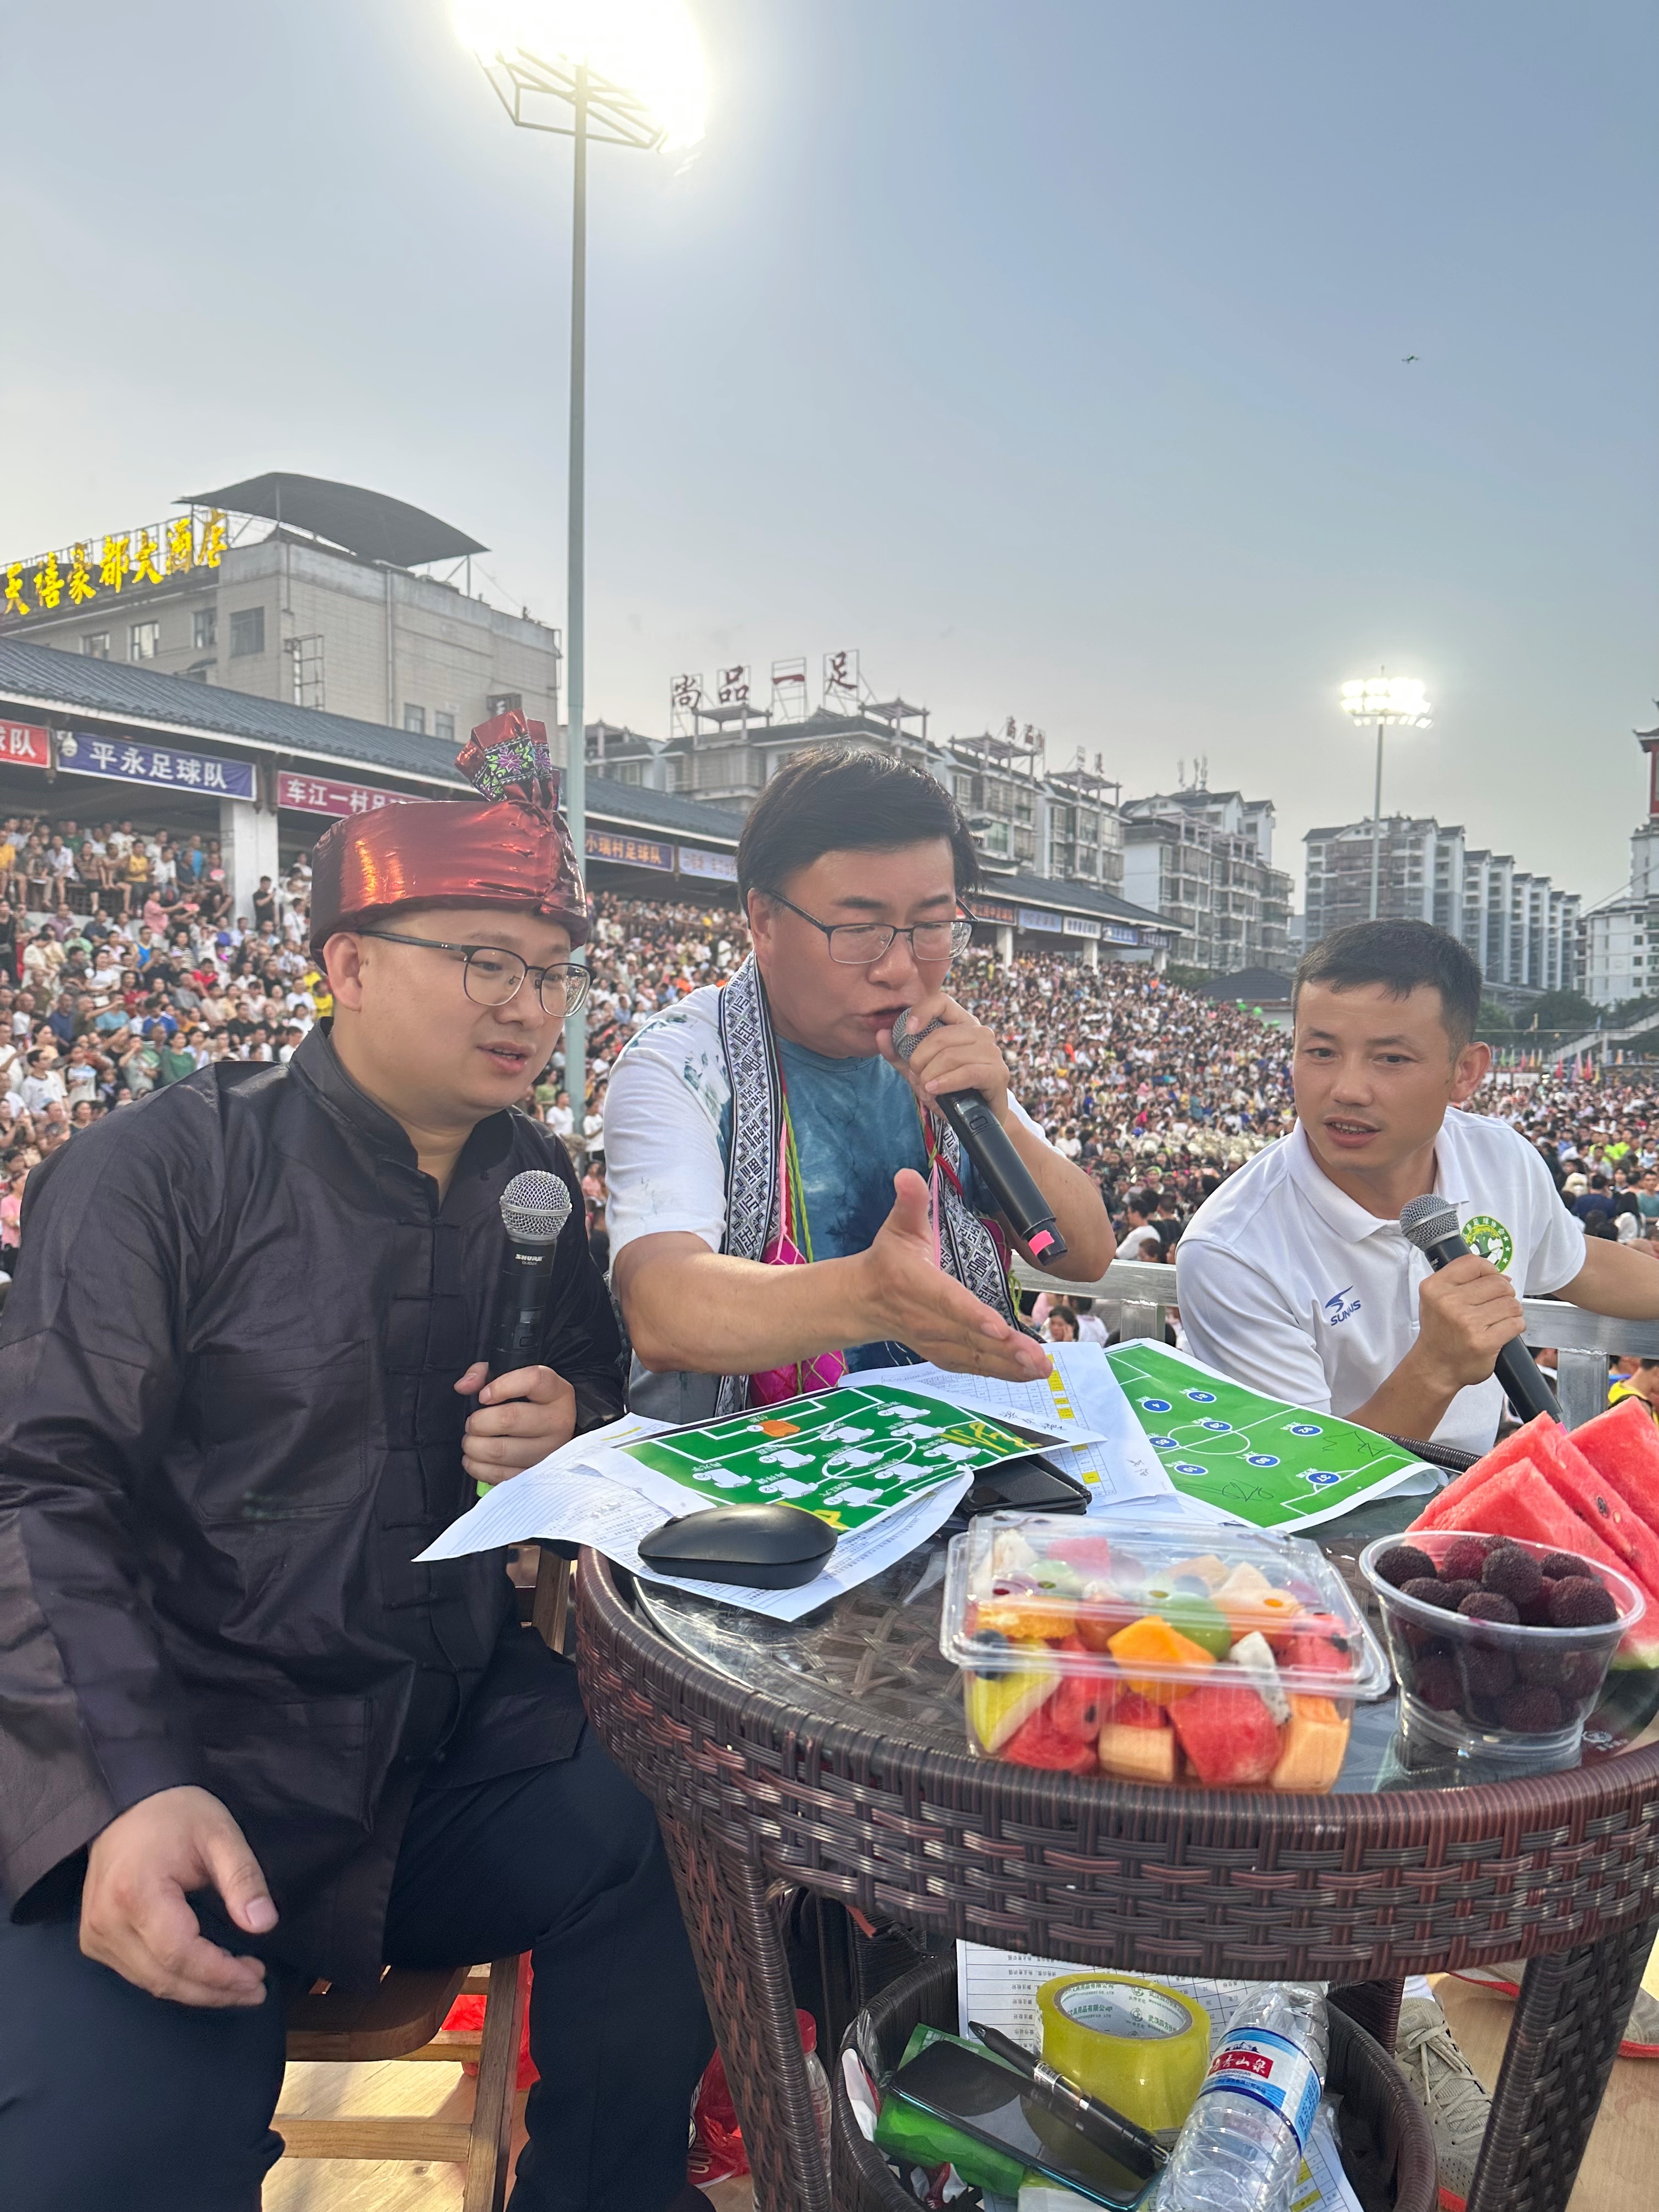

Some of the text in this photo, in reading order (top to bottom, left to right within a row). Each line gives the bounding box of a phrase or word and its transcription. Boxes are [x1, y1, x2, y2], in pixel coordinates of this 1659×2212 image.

[671, 651, 858, 710] 尚品一足
[89, 740, 228, 790] 平永足球队
[286, 778, 403, 813] 车江一村足
[515, 1253, 544, 1262] SHURE
